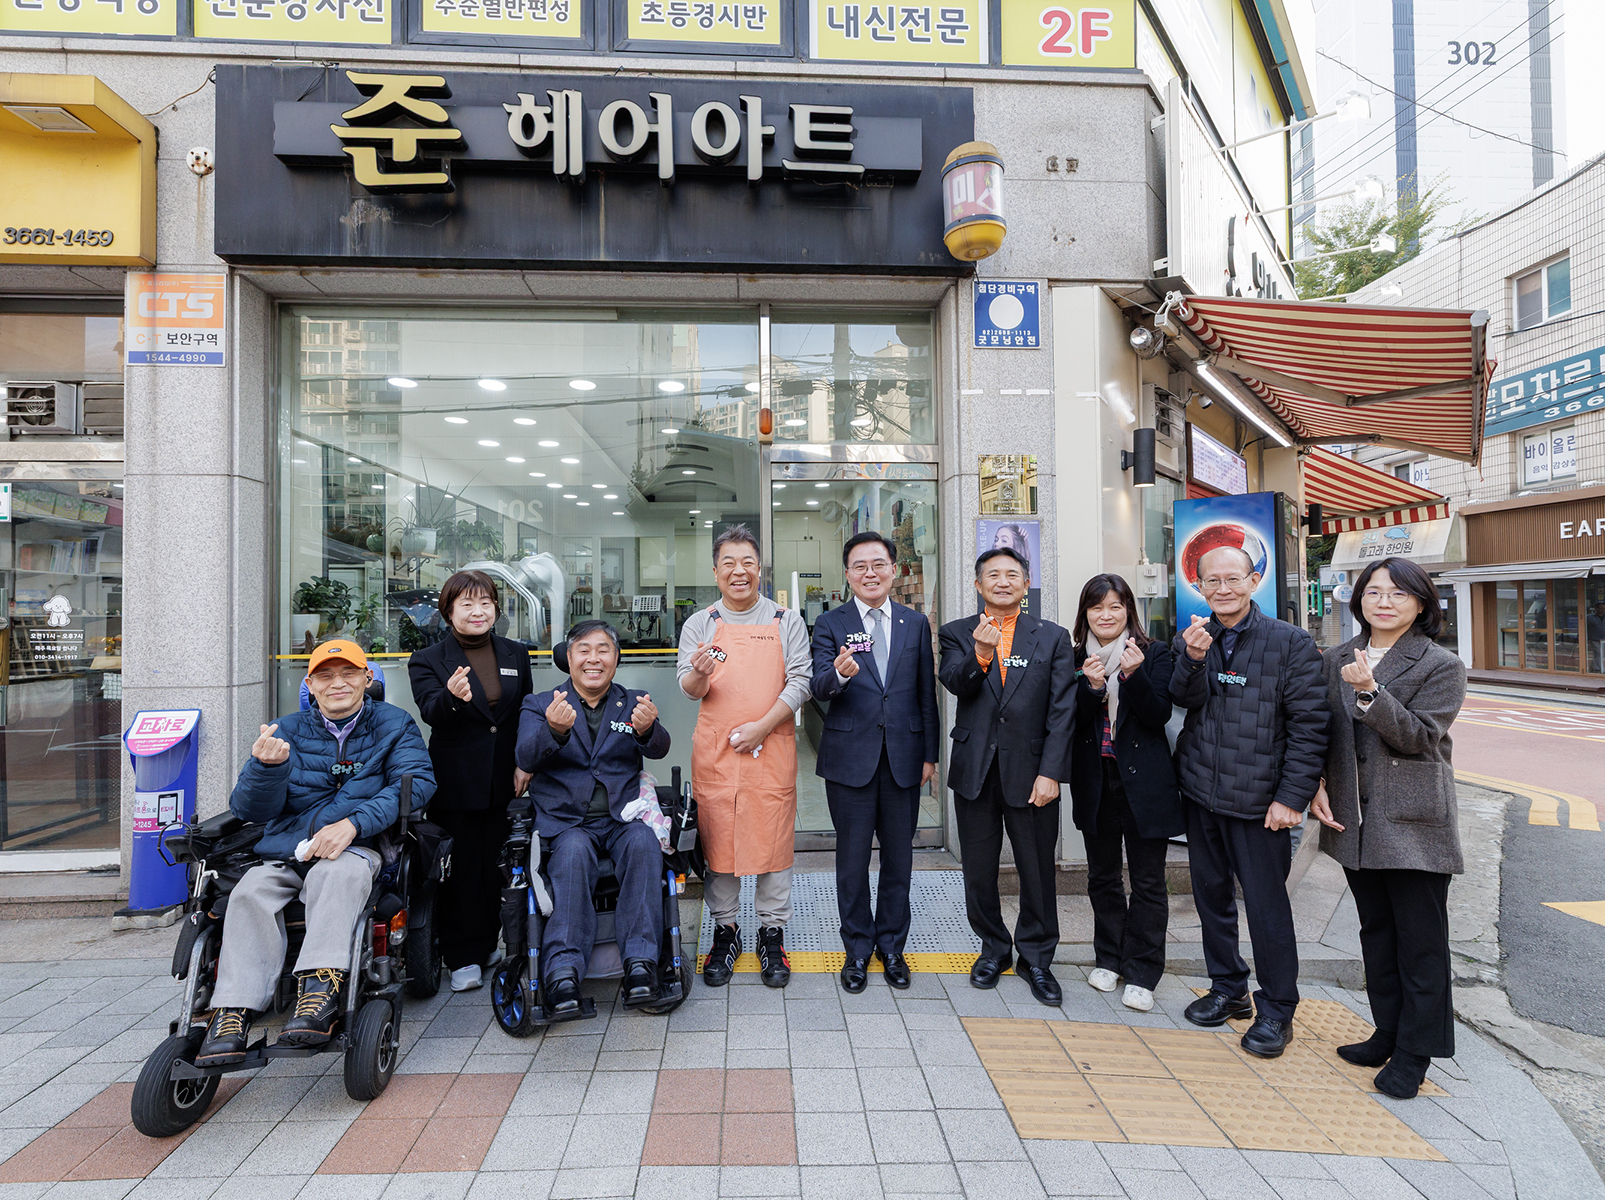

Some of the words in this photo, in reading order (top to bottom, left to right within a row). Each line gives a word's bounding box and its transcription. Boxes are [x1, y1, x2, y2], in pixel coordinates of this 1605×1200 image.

[641, 0, 767, 30] 초등경시반
[827, 6, 970, 44] 내신전문
[1041, 9, 1109, 54] 2F
[1447, 40, 1497, 66] 302
[330, 69, 464, 188] 준
[502, 87, 867, 184] 헤어아트
[3, 227, 114, 247] 3661-1459
[978, 284, 1035, 294] 첨단경비구역
[138, 292, 215, 319] CTS
[167, 333, 217, 346] 보안구역
[978, 335, 1036, 345] 굿모닝안전
[146, 354, 206, 362] 1544-4990
[1500, 355, 1605, 416] 모차르
[1386, 541, 1414, 555] 한의원
[138, 717, 187, 733] 교차로
